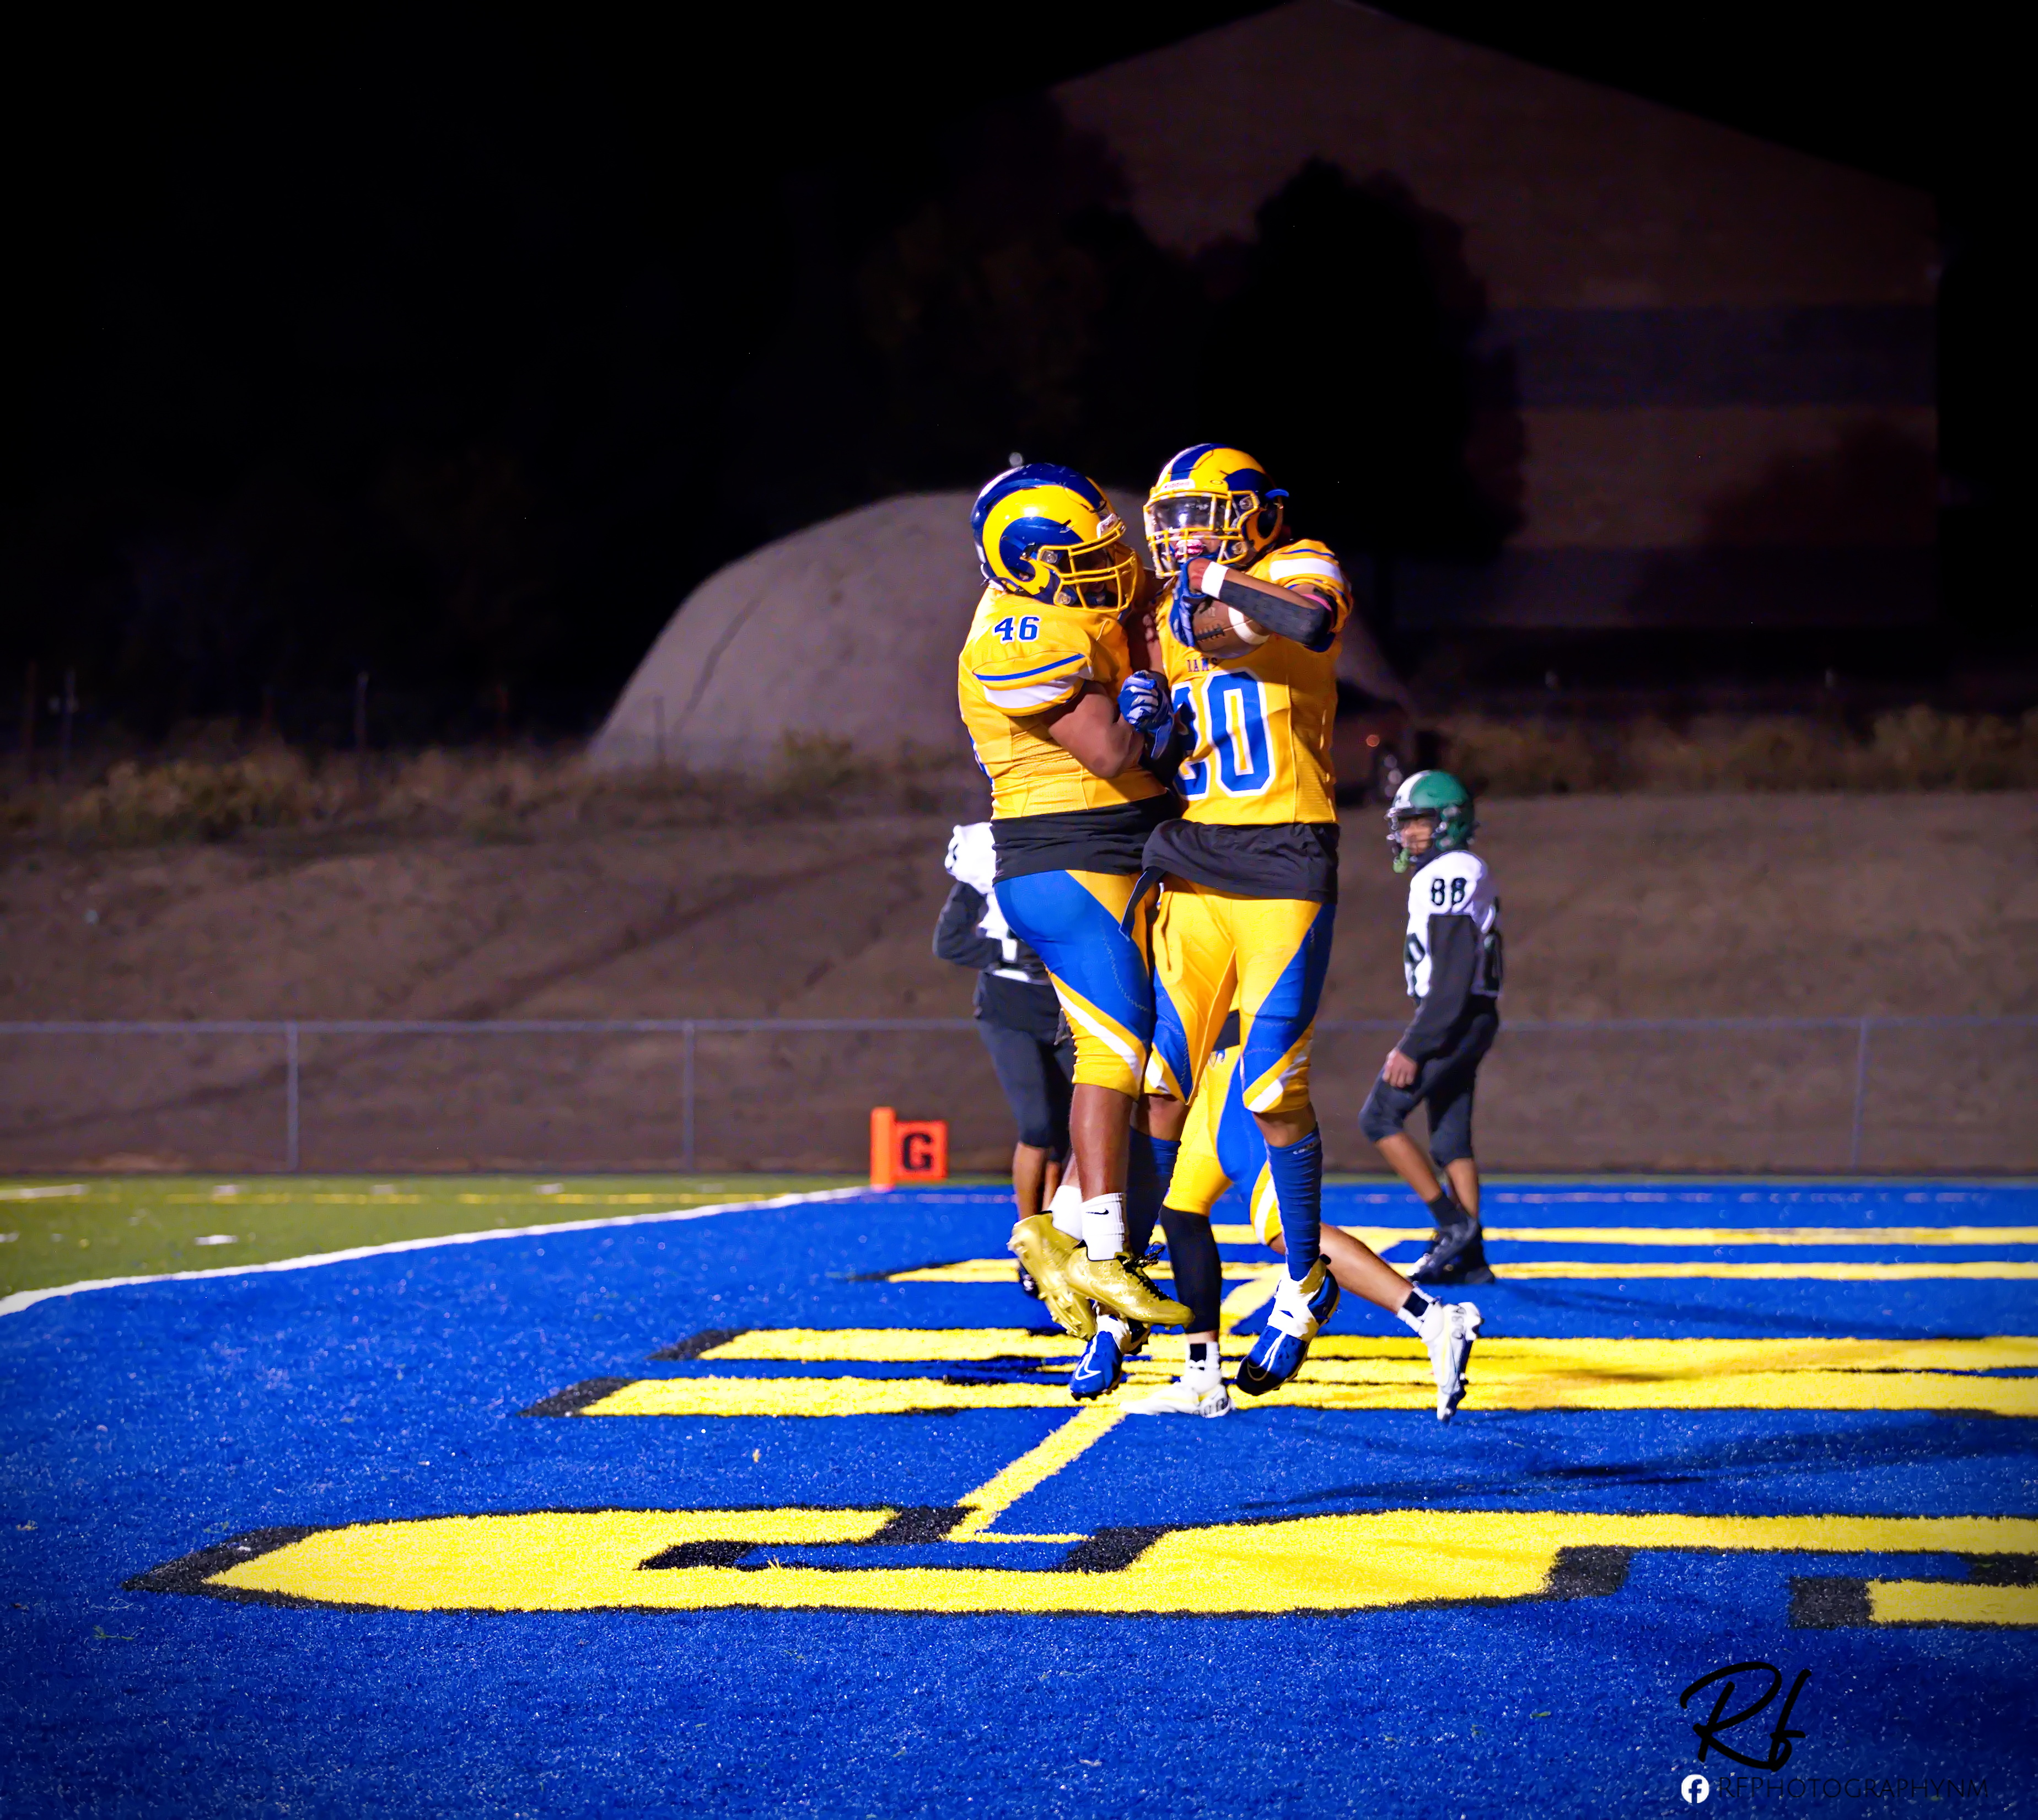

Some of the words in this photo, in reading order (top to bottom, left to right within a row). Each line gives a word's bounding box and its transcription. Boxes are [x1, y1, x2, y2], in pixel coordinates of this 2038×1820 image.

[993, 616, 1040, 643] 46
[1432, 877, 1467, 906] 88
[903, 1133, 933, 1170] G
